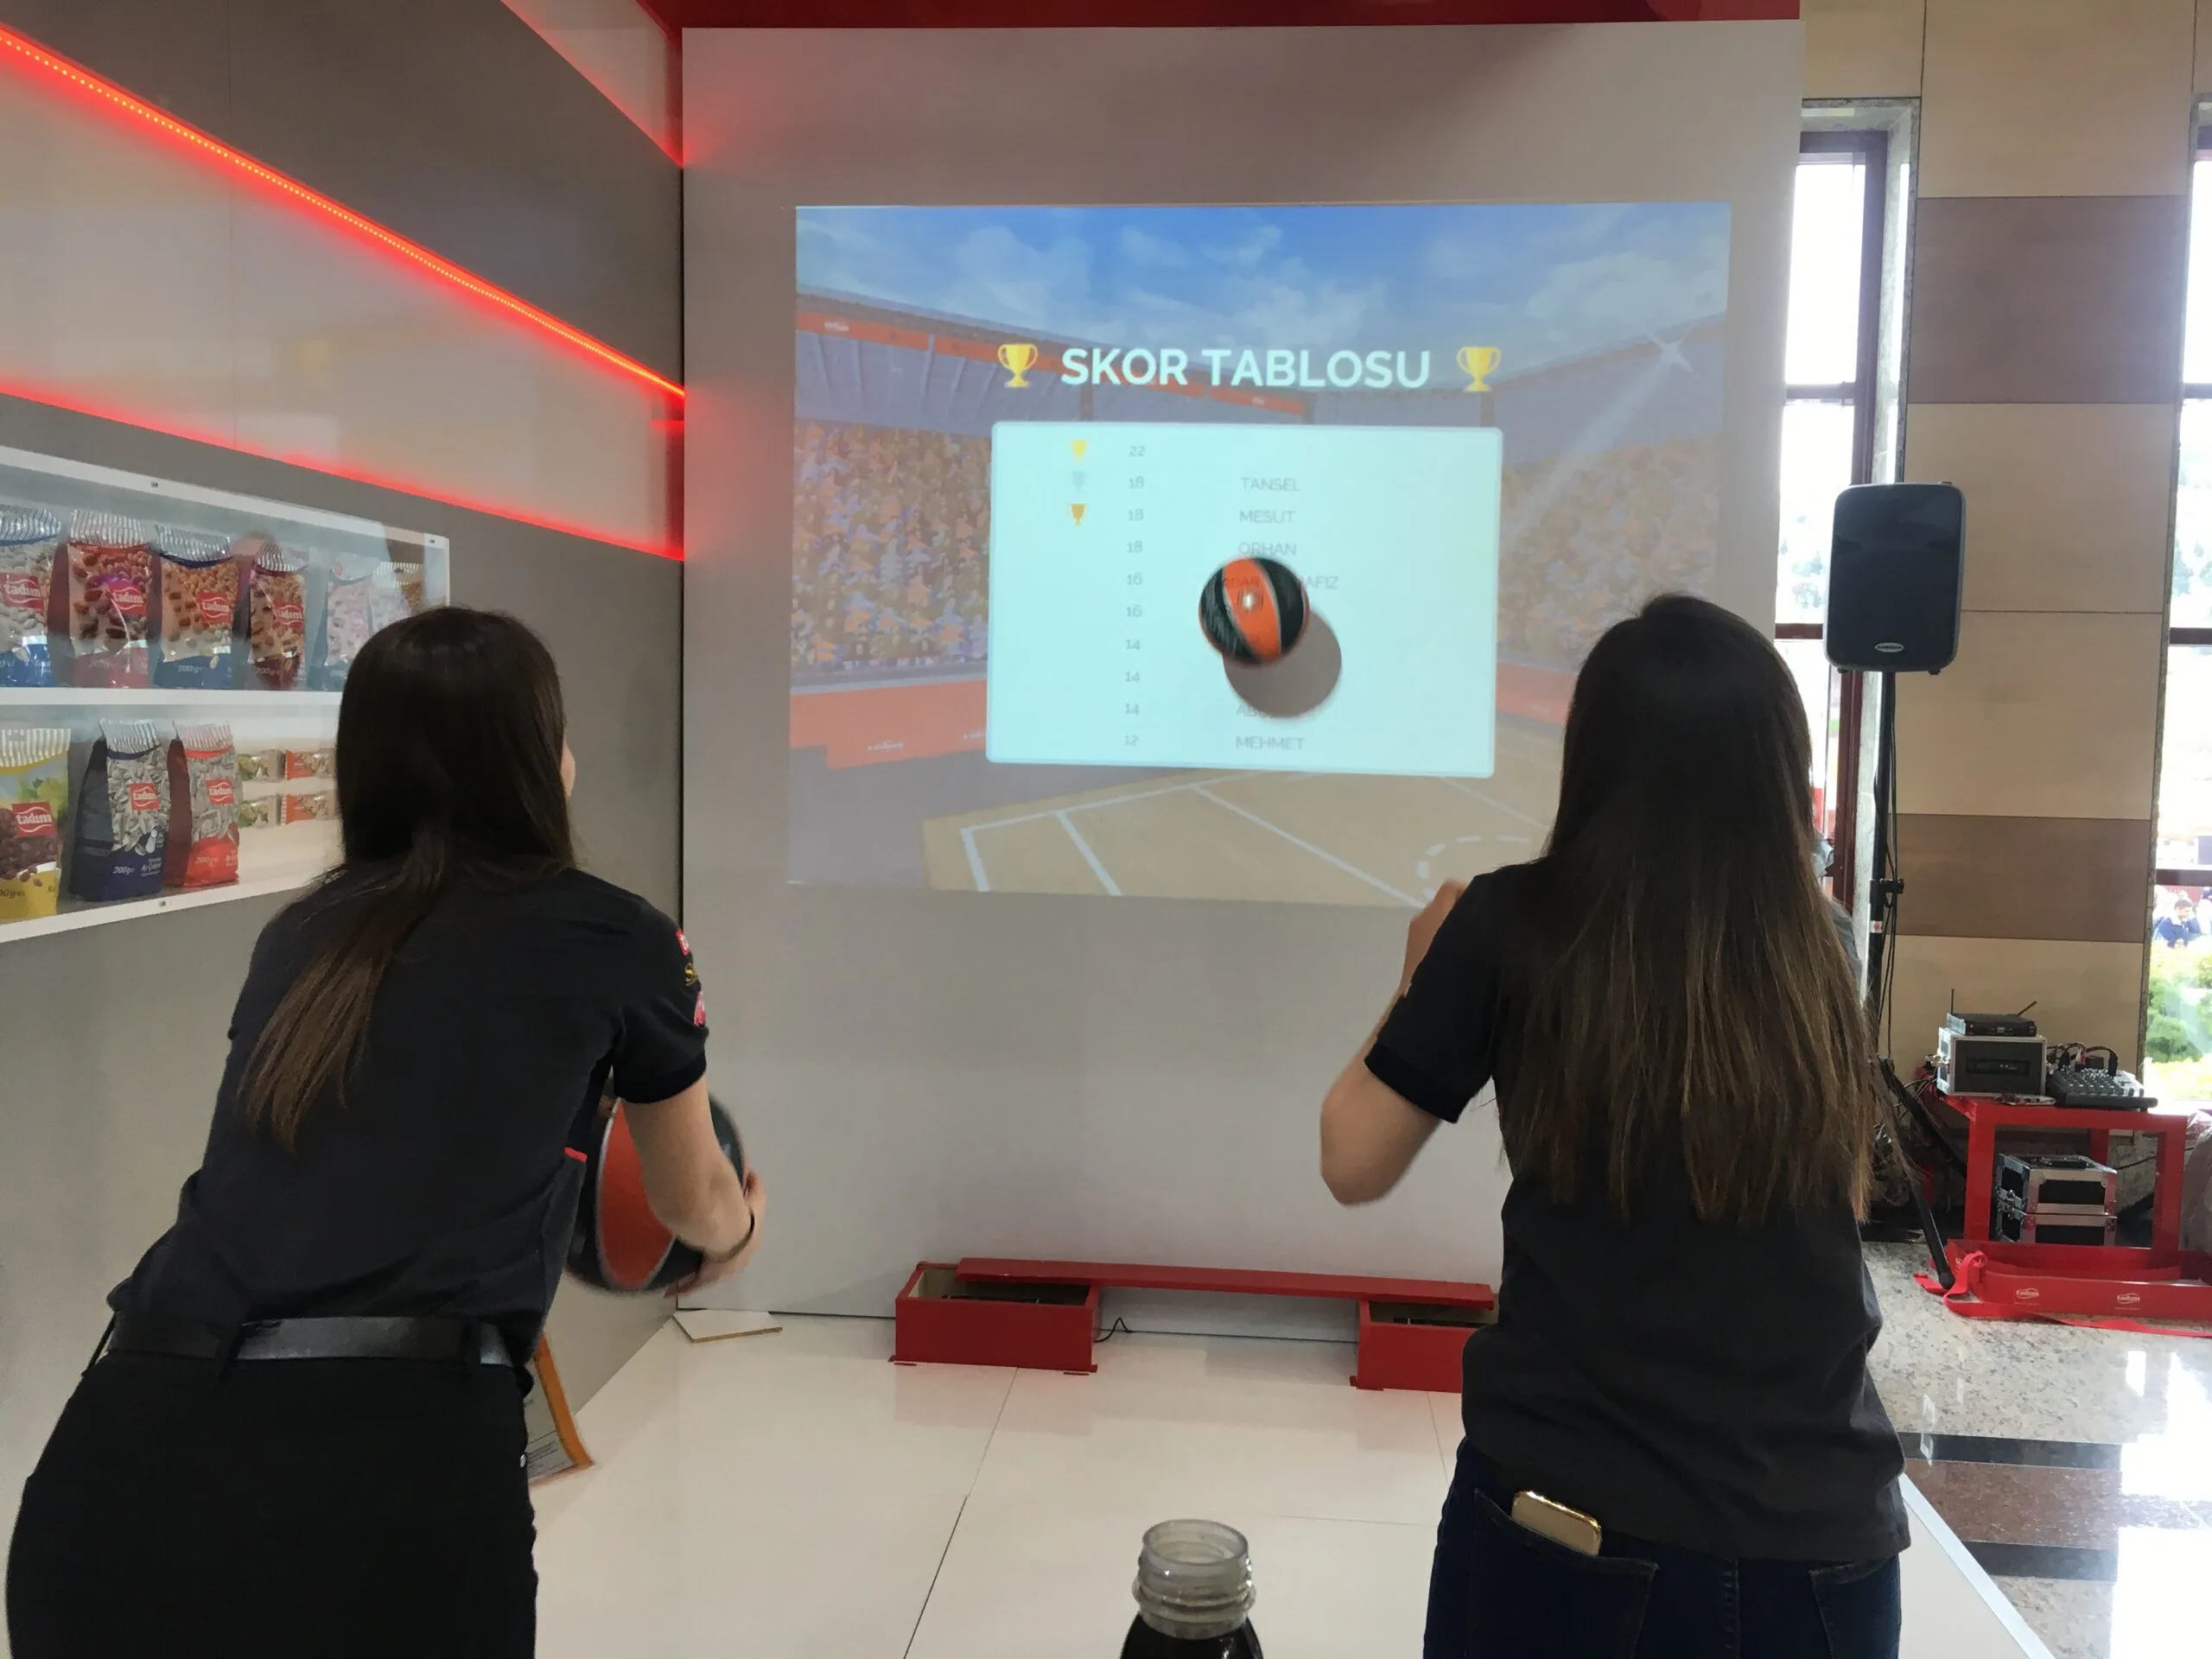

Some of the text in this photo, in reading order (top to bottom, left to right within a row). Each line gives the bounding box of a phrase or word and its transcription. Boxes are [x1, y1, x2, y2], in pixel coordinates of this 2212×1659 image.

[1061, 347, 1431, 389] SKOR TABLOSU
[1128, 446, 1147, 457] 22
[1129, 476, 1300, 492] 18 TANSEL
[1129, 509, 1295, 524] 18 MESUT
[1128, 541, 1296, 556] 18 ORHAN
[1127, 573, 1143, 586] 16
[1303, 576, 1339, 589] AFIZ
[1126, 605, 1142, 618] 16
[1126, 639, 1141, 652] 14
[1125, 671, 1141, 683] 14
[1124, 703, 1140, 716] 14
[1124, 735, 1305, 750] 12 MEHMET
